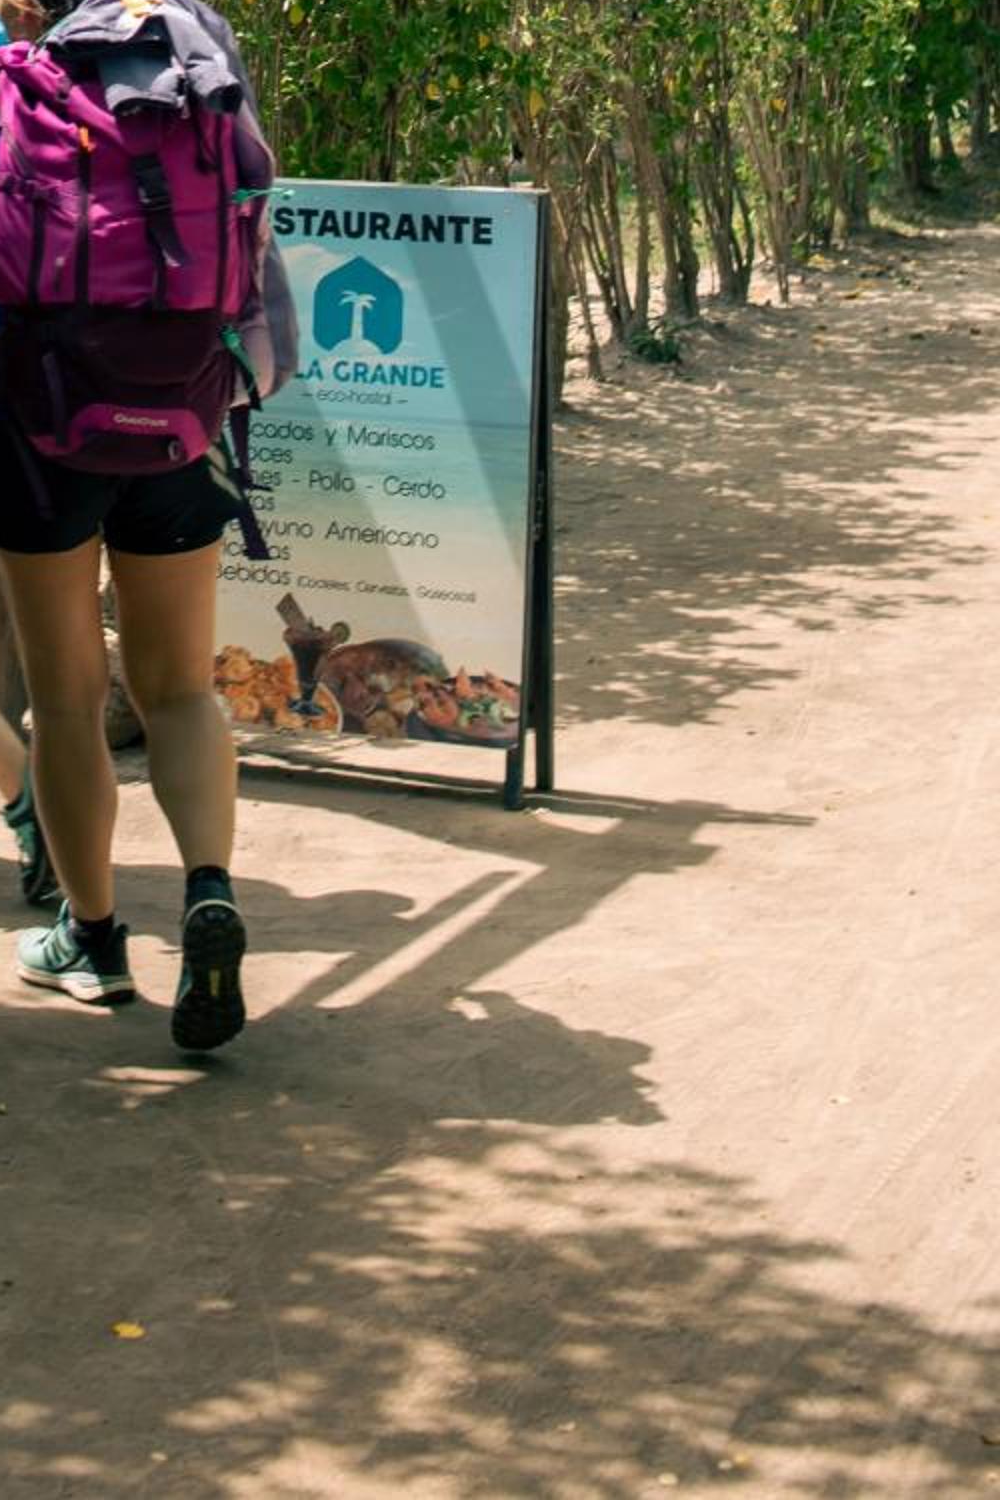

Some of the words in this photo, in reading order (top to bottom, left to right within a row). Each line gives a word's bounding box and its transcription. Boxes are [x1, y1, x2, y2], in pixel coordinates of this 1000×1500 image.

[273, 206, 493, 245] STAURANTE
[333, 360, 445, 388] GRANDE
[324, 427, 337, 447] y
[347, 425, 435, 451] Mariscos
[308, 470, 356, 493] Pollo
[383, 475, 447, 500] Cerdo
[324, 520, 440, 549] Americano
